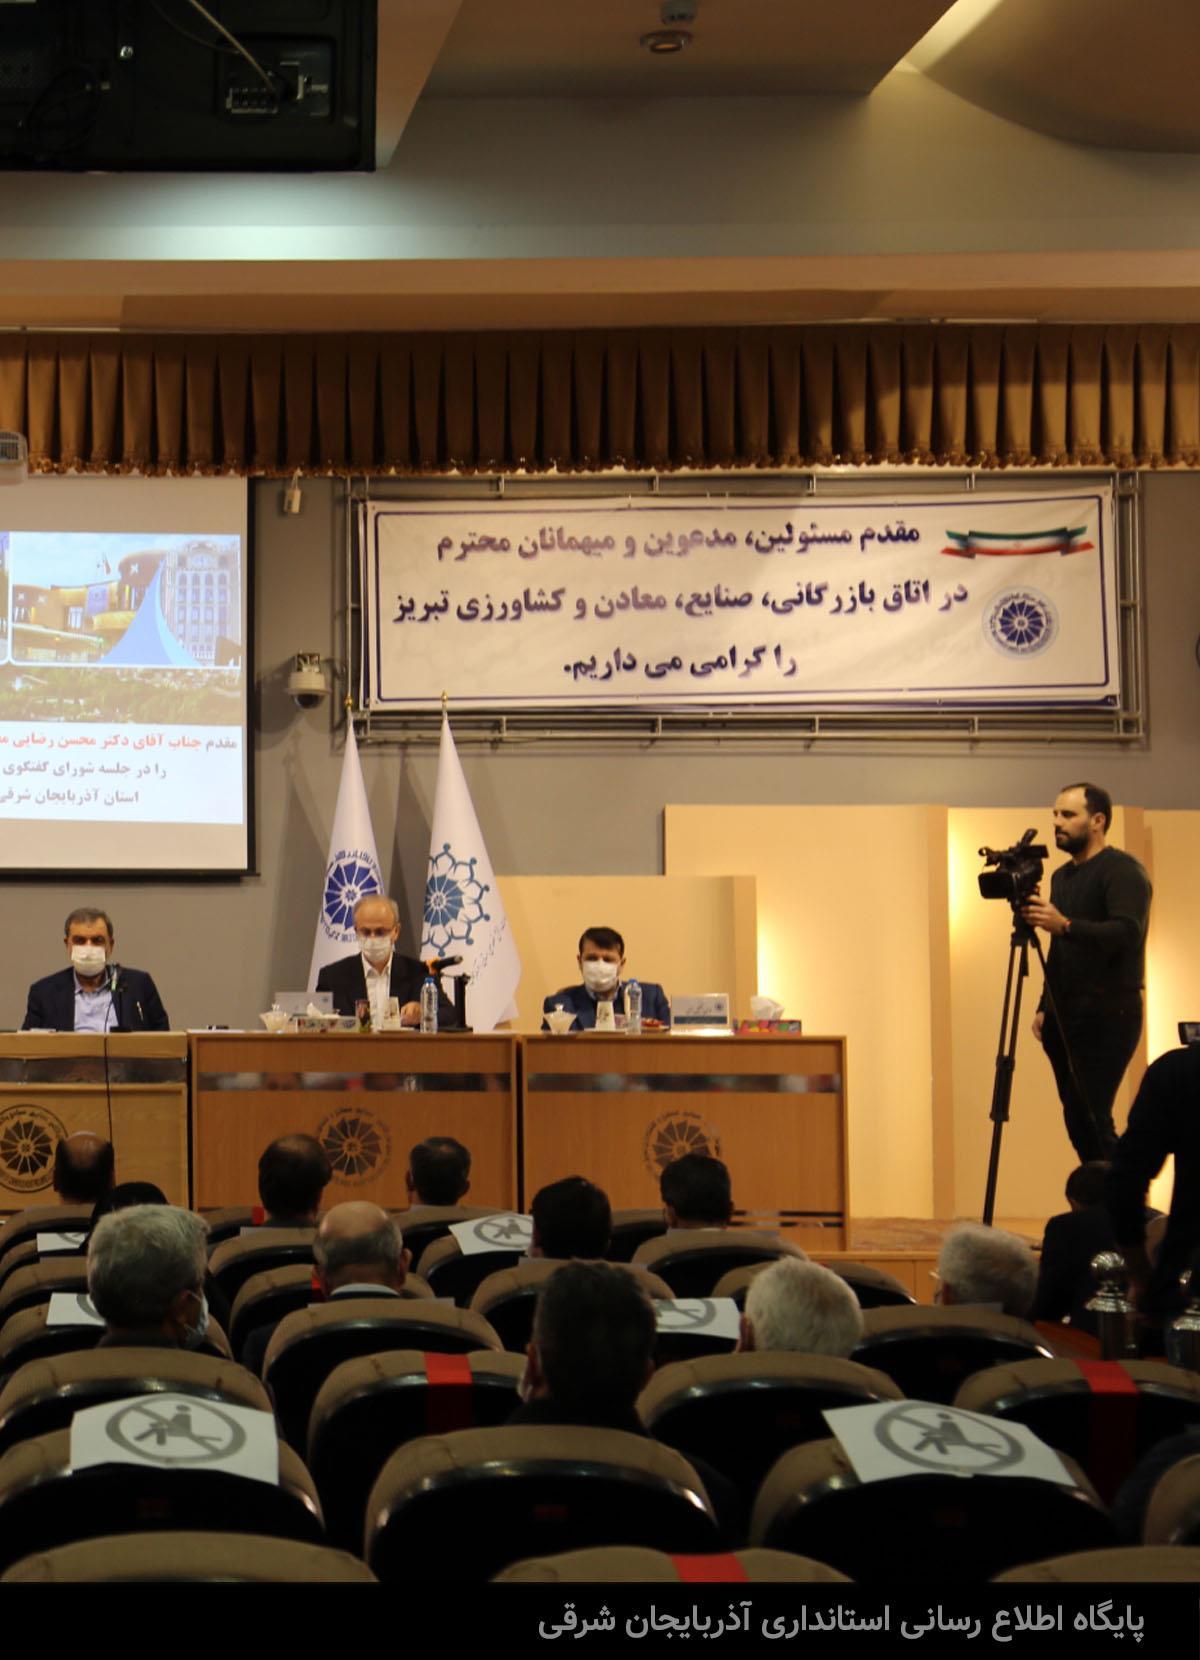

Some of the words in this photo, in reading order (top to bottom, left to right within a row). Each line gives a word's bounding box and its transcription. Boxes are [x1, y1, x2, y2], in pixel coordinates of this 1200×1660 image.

[437, 532, 511, 561] محترم
[518, 526, 615, 559] میهمانان
[623, 535, 636, 558] و
[644, 528, 736, 557] مدعوین
[745, 521, 852, 554] مسئولین،
[860, 521, 920, 552] مقدم
[392, 589, 449, 623] تبریز
[456, 587, 566, 622] کشاورزی
[573, 597, 587, 619] و
[594, 585, 667, 618] معادن
[675, 584, 753, 617] صنایع،
[762, 580, 876, 614] بازرگانی،
[883, 579, 930, 612] اتاق
[939, 584, 968, 612] در
[563, 647, 637, 680] داریم.
[644, 654, 683, 678] می
[689, 644, 766, 678] گرامی
[773, 644, 797, 677] را
